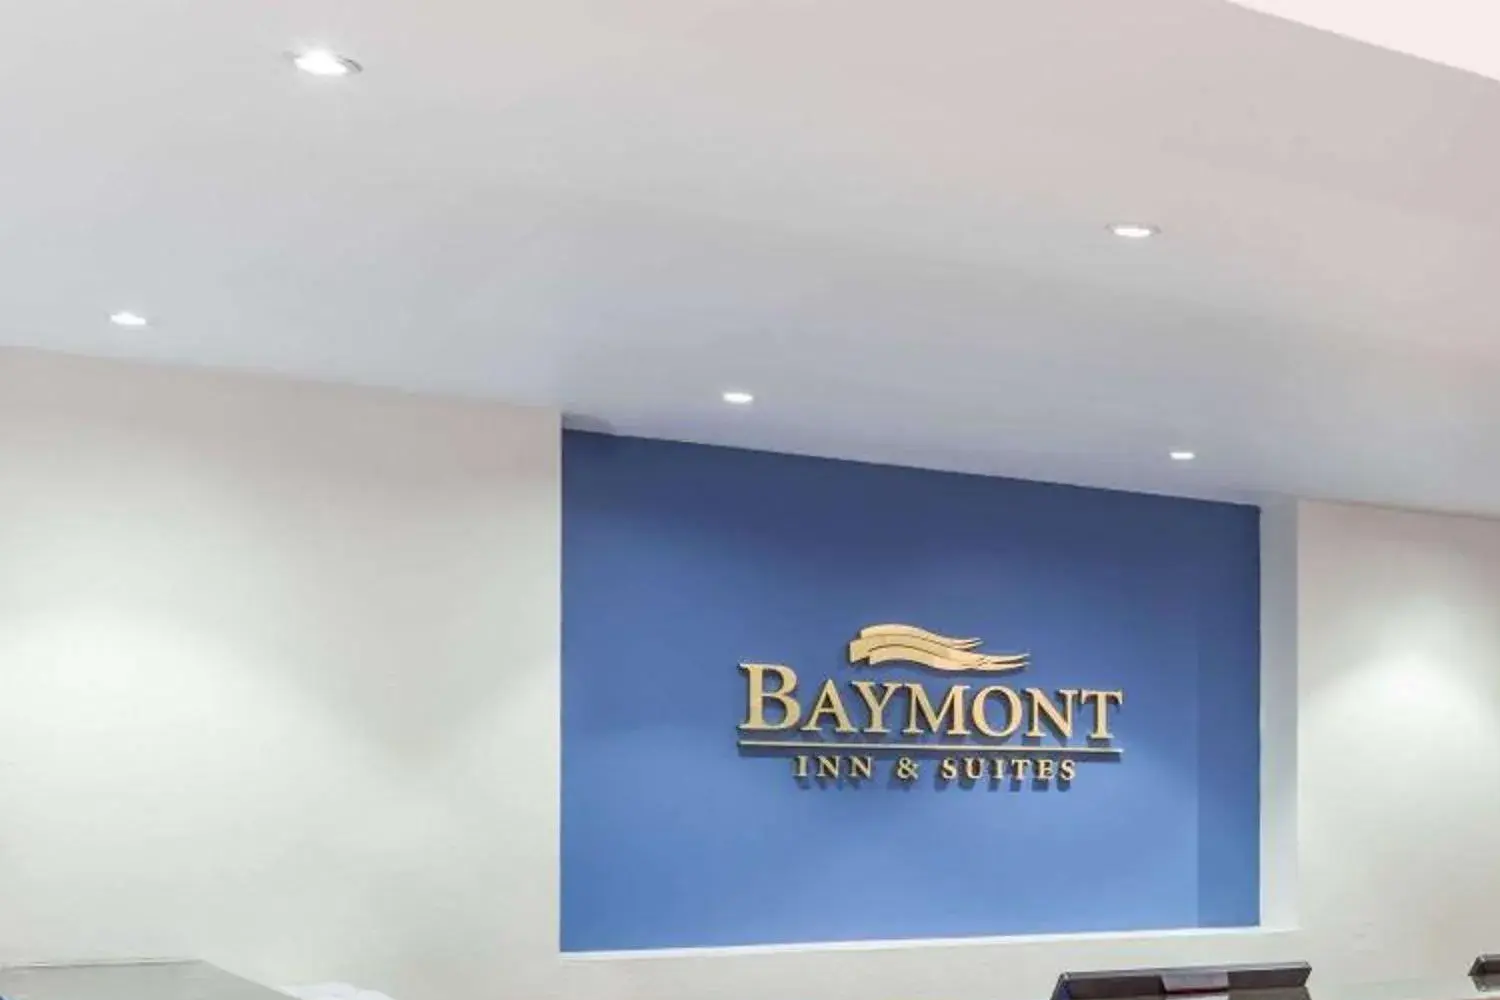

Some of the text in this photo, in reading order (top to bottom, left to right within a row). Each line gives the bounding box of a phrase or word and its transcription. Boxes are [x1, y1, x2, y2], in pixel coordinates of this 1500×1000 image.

[738, 662, 1123, 739] BAYMONT
[794, 755, 1077, 781] INN & SUITES
